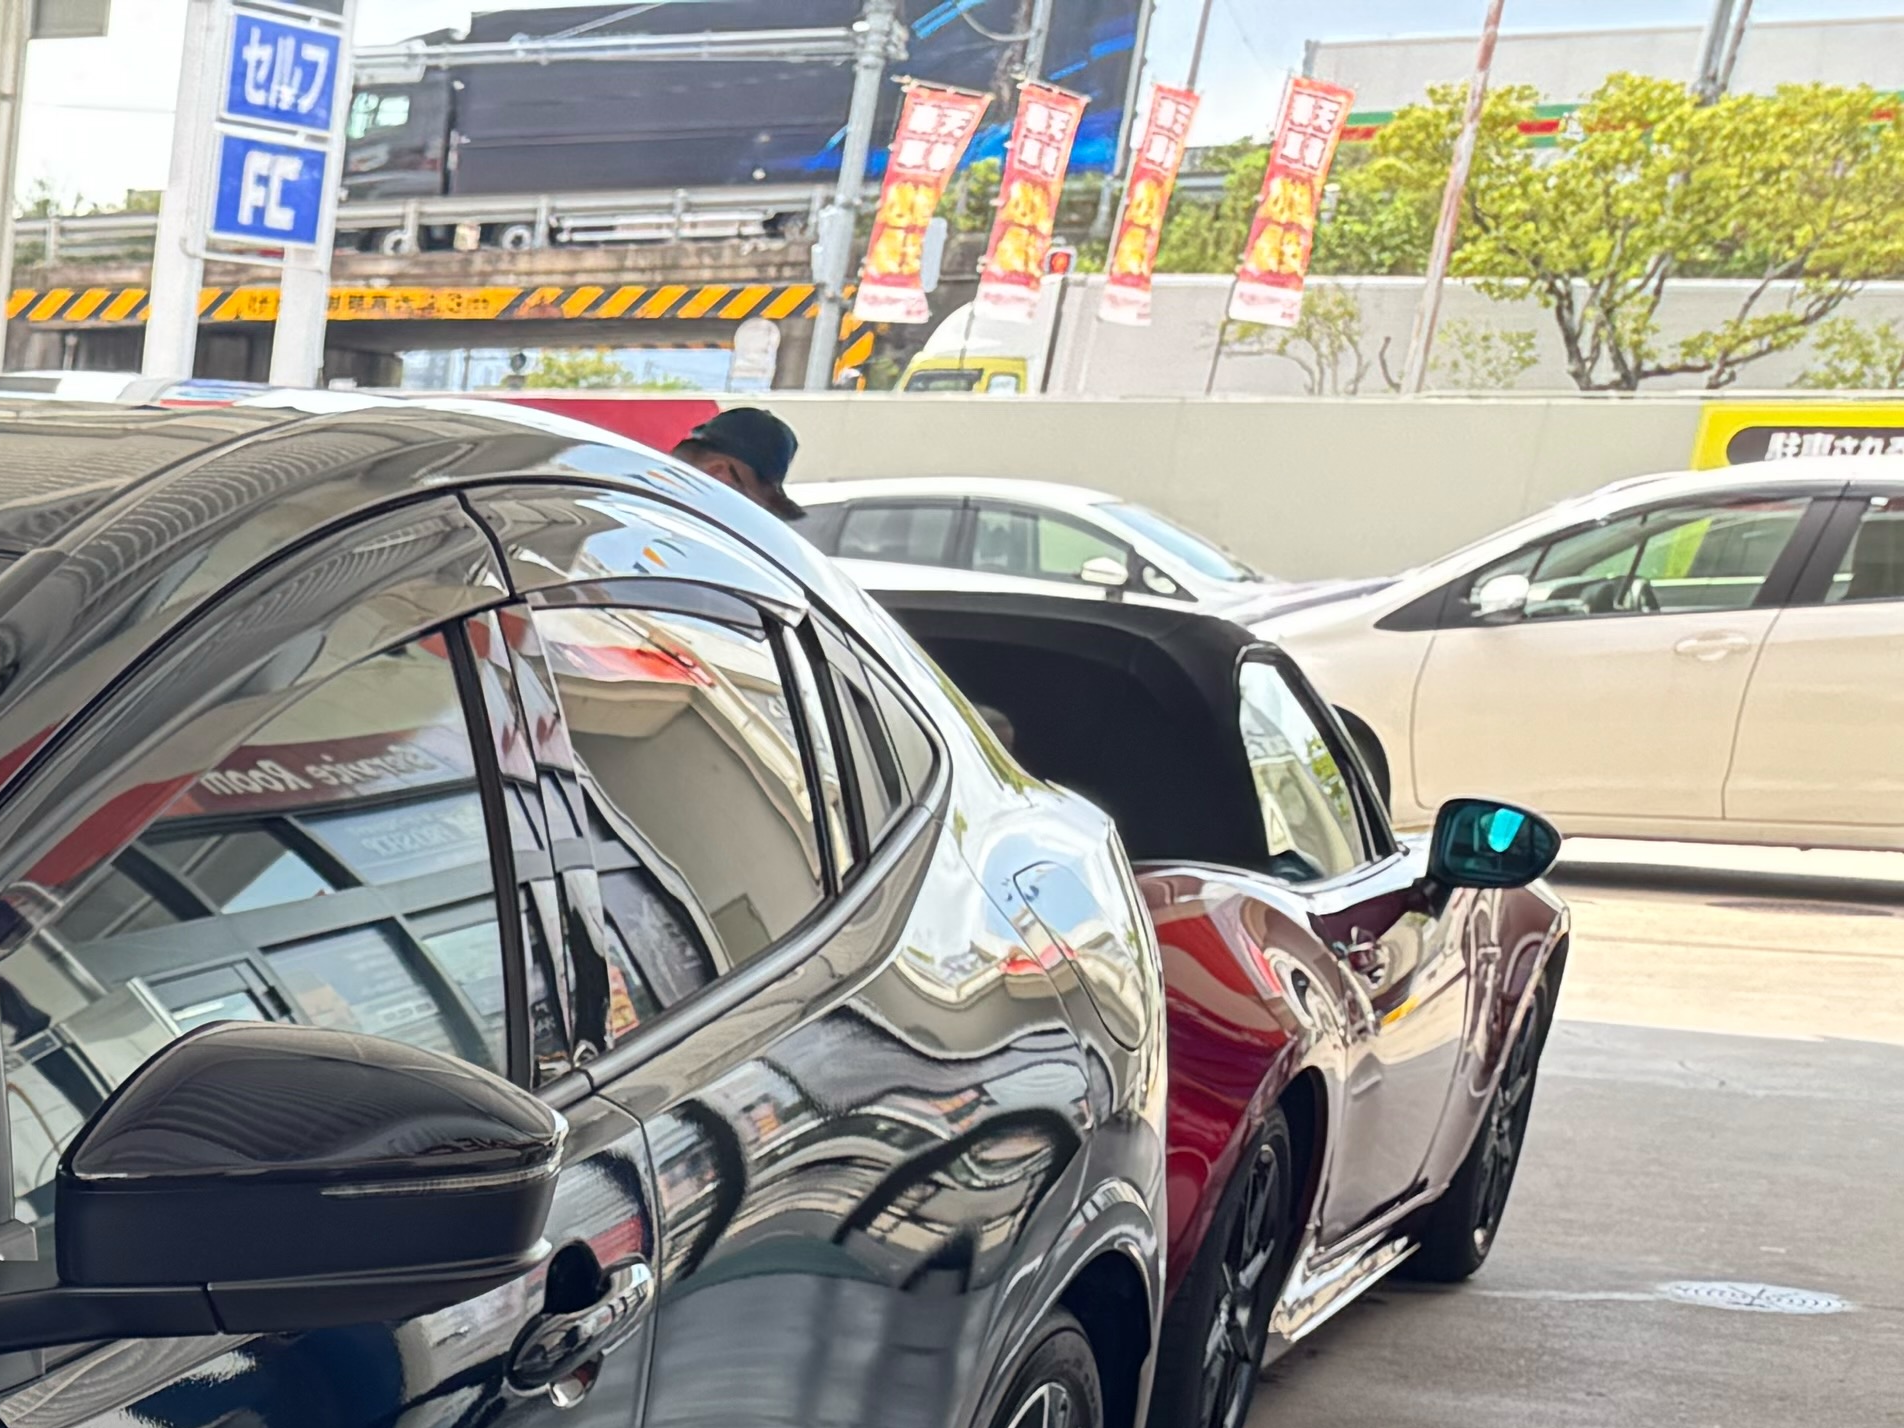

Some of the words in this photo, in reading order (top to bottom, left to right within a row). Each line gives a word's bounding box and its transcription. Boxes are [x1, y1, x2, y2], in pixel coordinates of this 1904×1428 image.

[242, 26, 329, 114] セルフ
[237, 150, 304, 231] FC
